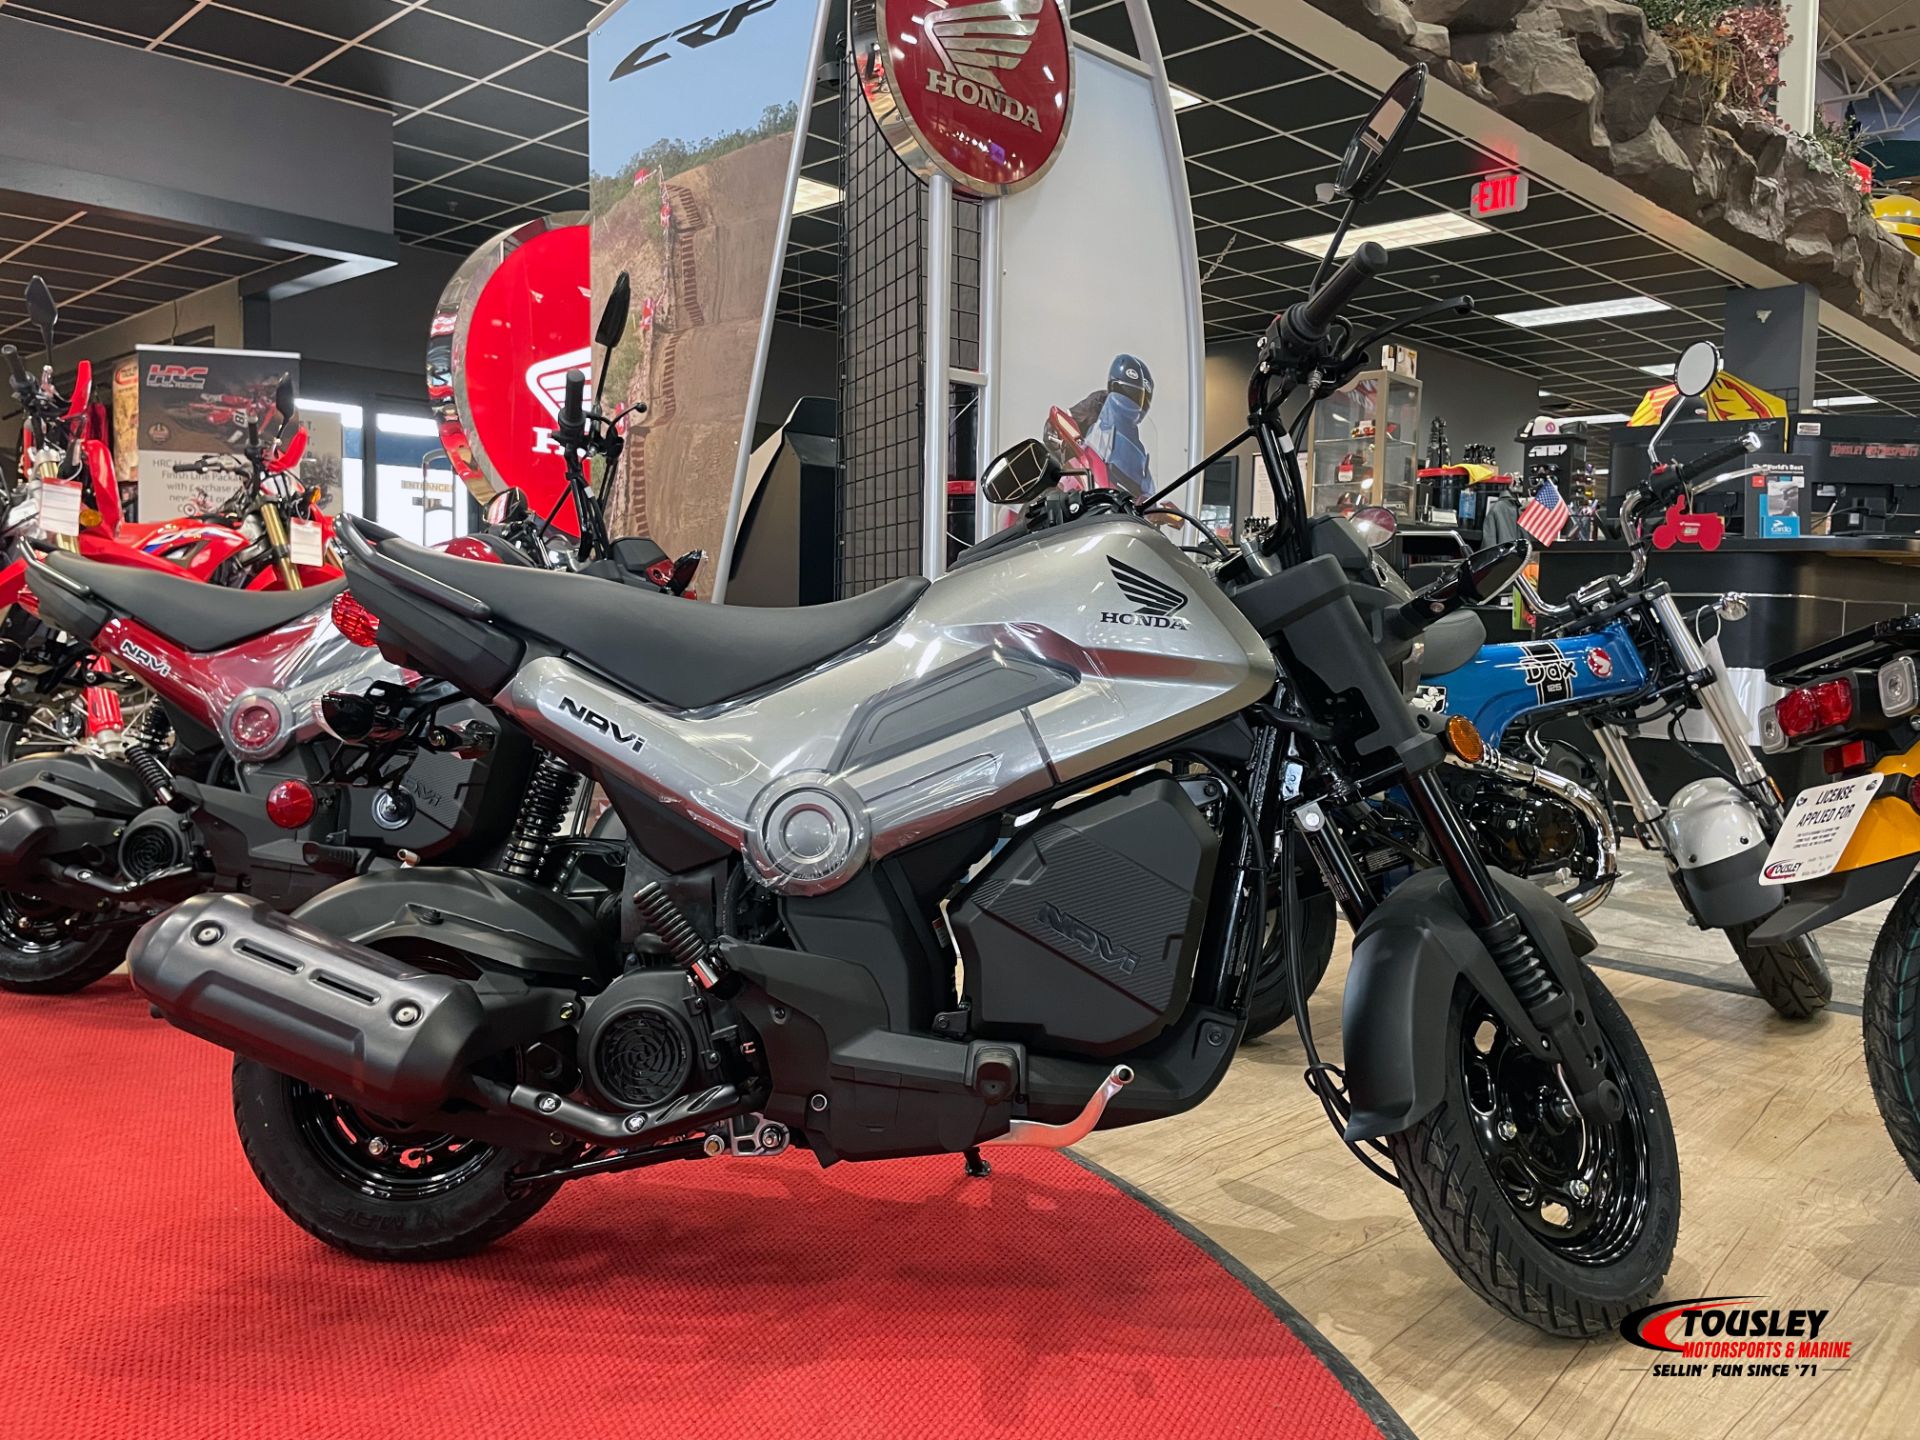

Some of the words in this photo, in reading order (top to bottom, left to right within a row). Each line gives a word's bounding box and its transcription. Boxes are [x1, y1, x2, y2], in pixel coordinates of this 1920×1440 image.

[926, 67, 1042, 133] HONDA
[1478, 174, 1520, 214] EXIT
[146, 364, 209, 386] HRC
[152, 459, 172, 468] HRC
[167, 482, 188, 491] with
[189, 483, 231, 494] prchase
[1100, 611, 1187, 631] HONDA
[1519, 658, 1578, 686] Dax
[1816, 785, 1856, 805] LICENSE
[1797, 808, 1836, 827] APPLIED
[1834, 804, 1855, 820] FOR
